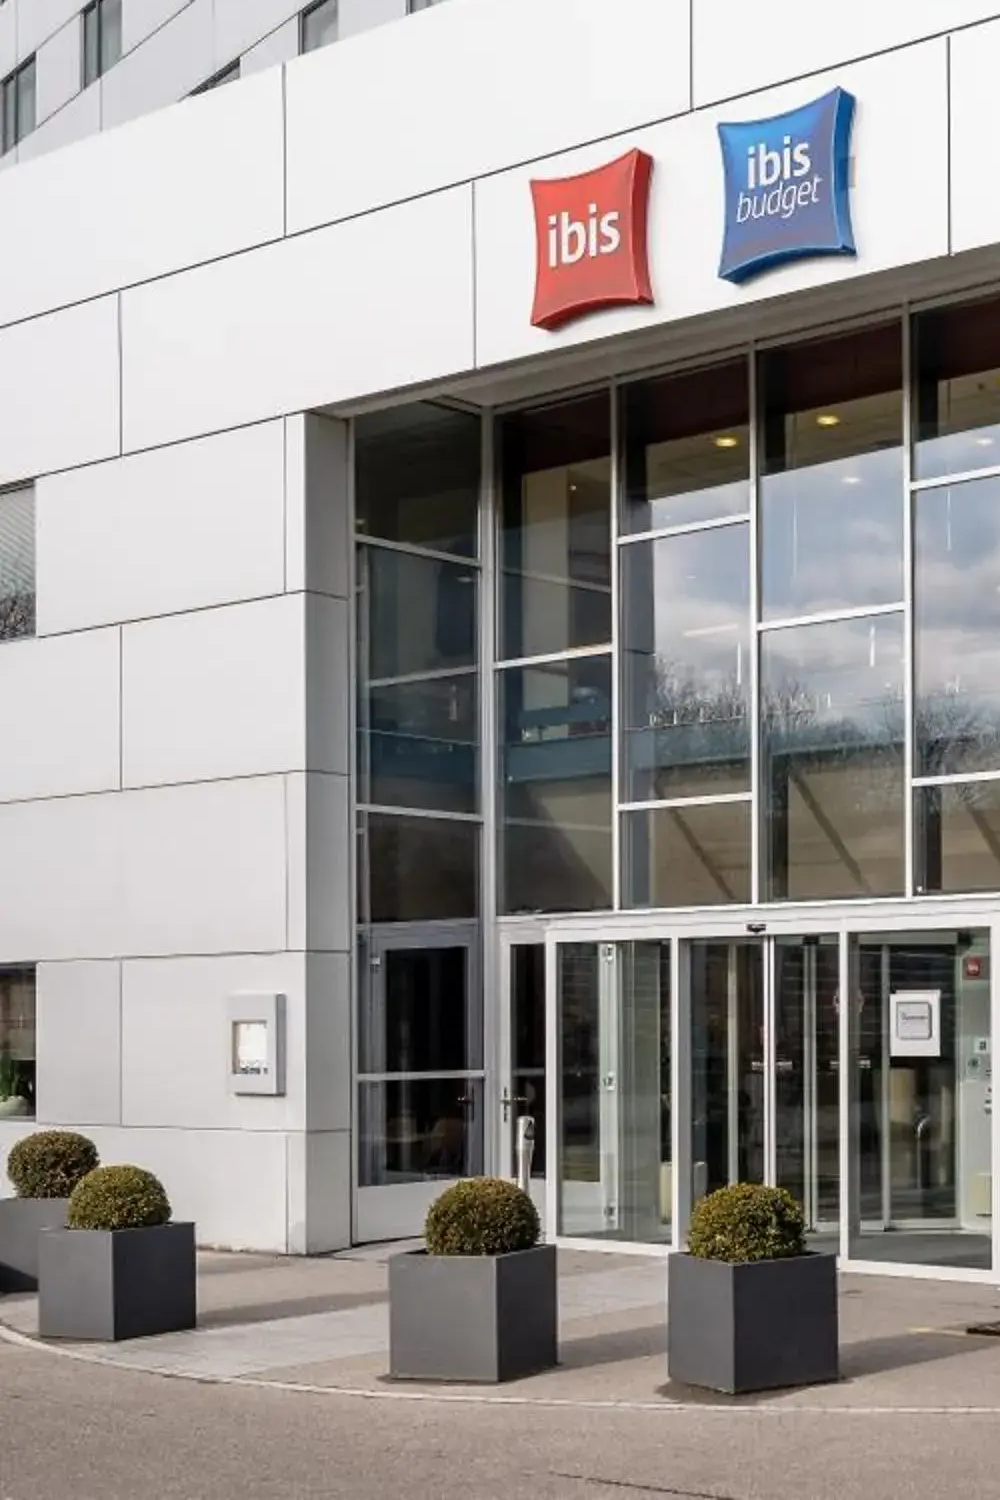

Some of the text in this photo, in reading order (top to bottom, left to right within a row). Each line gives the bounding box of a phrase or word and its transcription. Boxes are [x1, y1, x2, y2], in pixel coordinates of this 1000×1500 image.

[747, 135, 811, 189] ibis
[736, 175, 822, 222] budget
[548, 202, 621, 268] ibis
